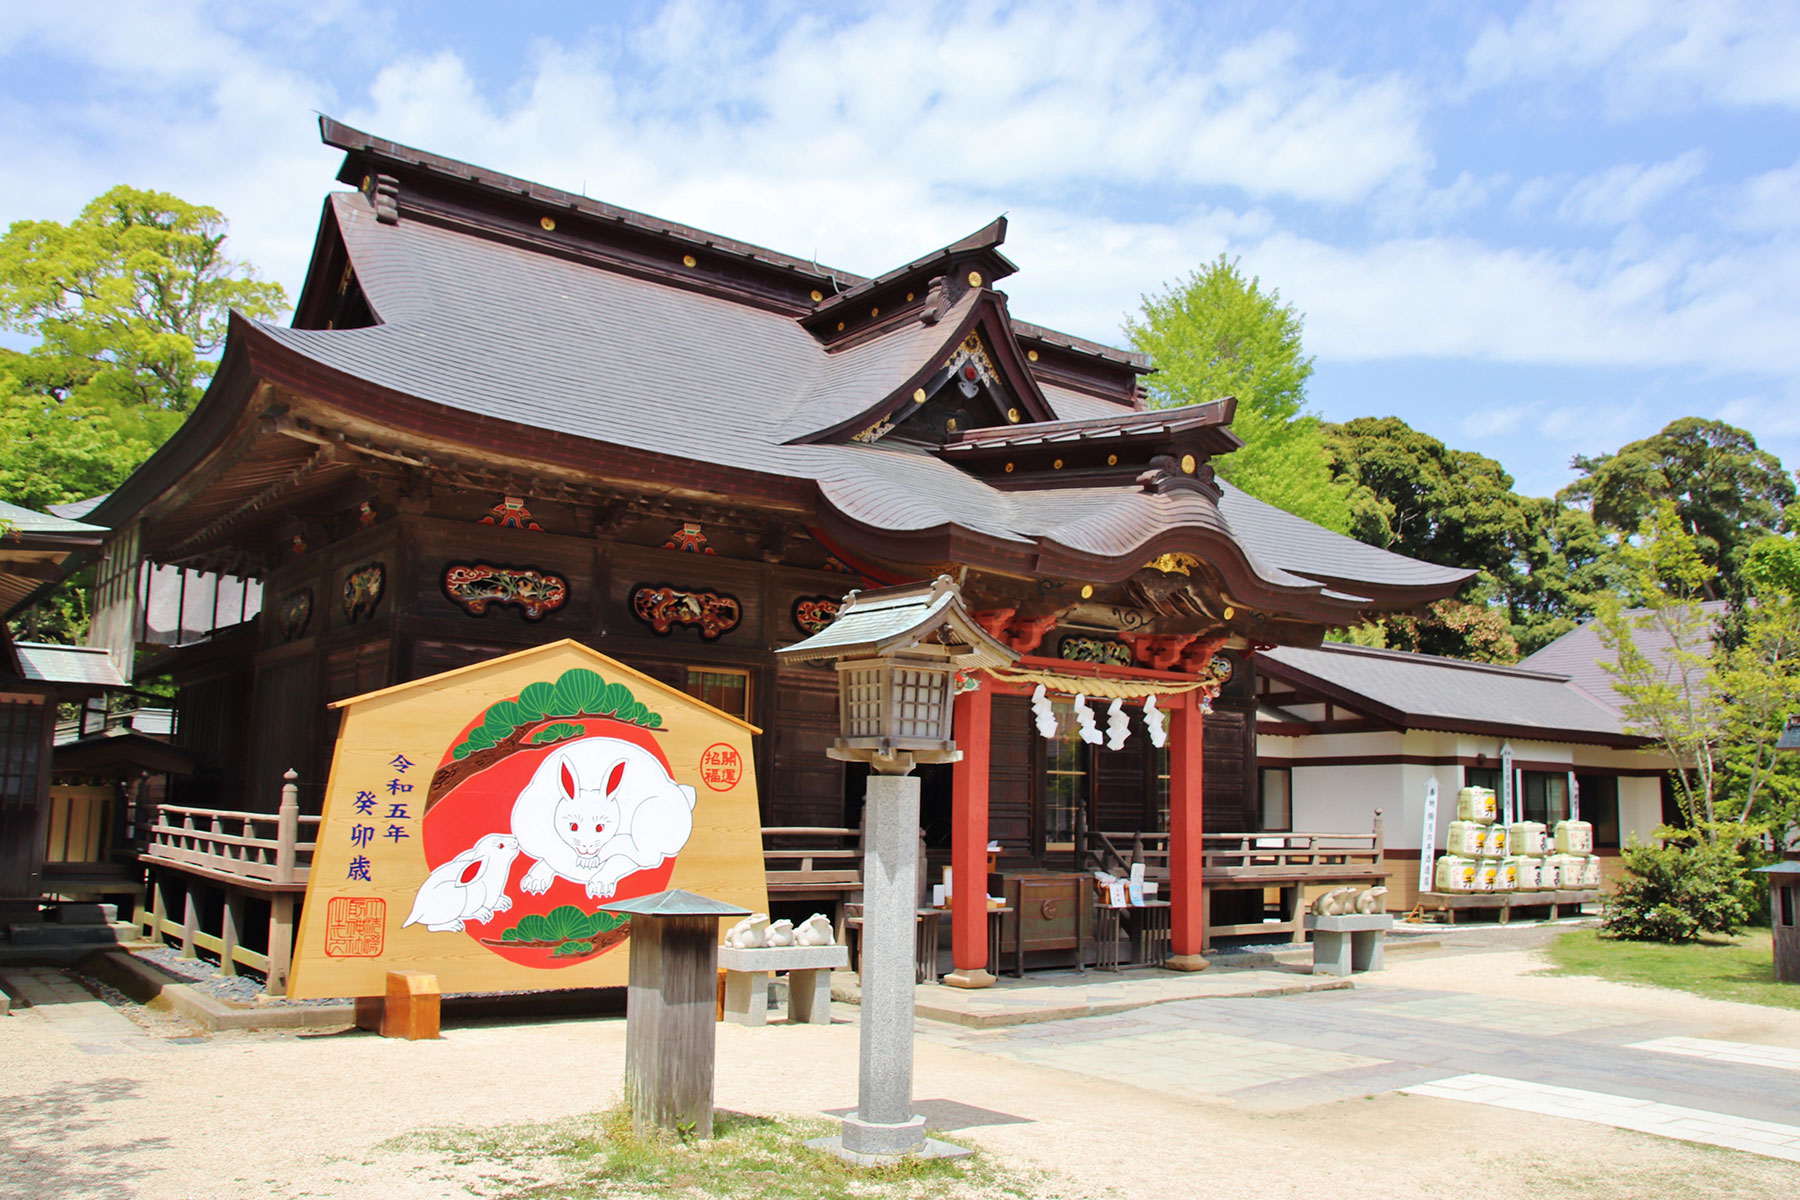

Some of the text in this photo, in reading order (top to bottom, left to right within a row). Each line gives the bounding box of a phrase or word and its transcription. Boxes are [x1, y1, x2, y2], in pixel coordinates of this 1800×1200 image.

[382, 754, 416, 844] 令和五年
[704, 751, 721, 784] 招福
[720, 751, 737, 787] 開運
[346, 790, 379, 882] 癸卯歳
